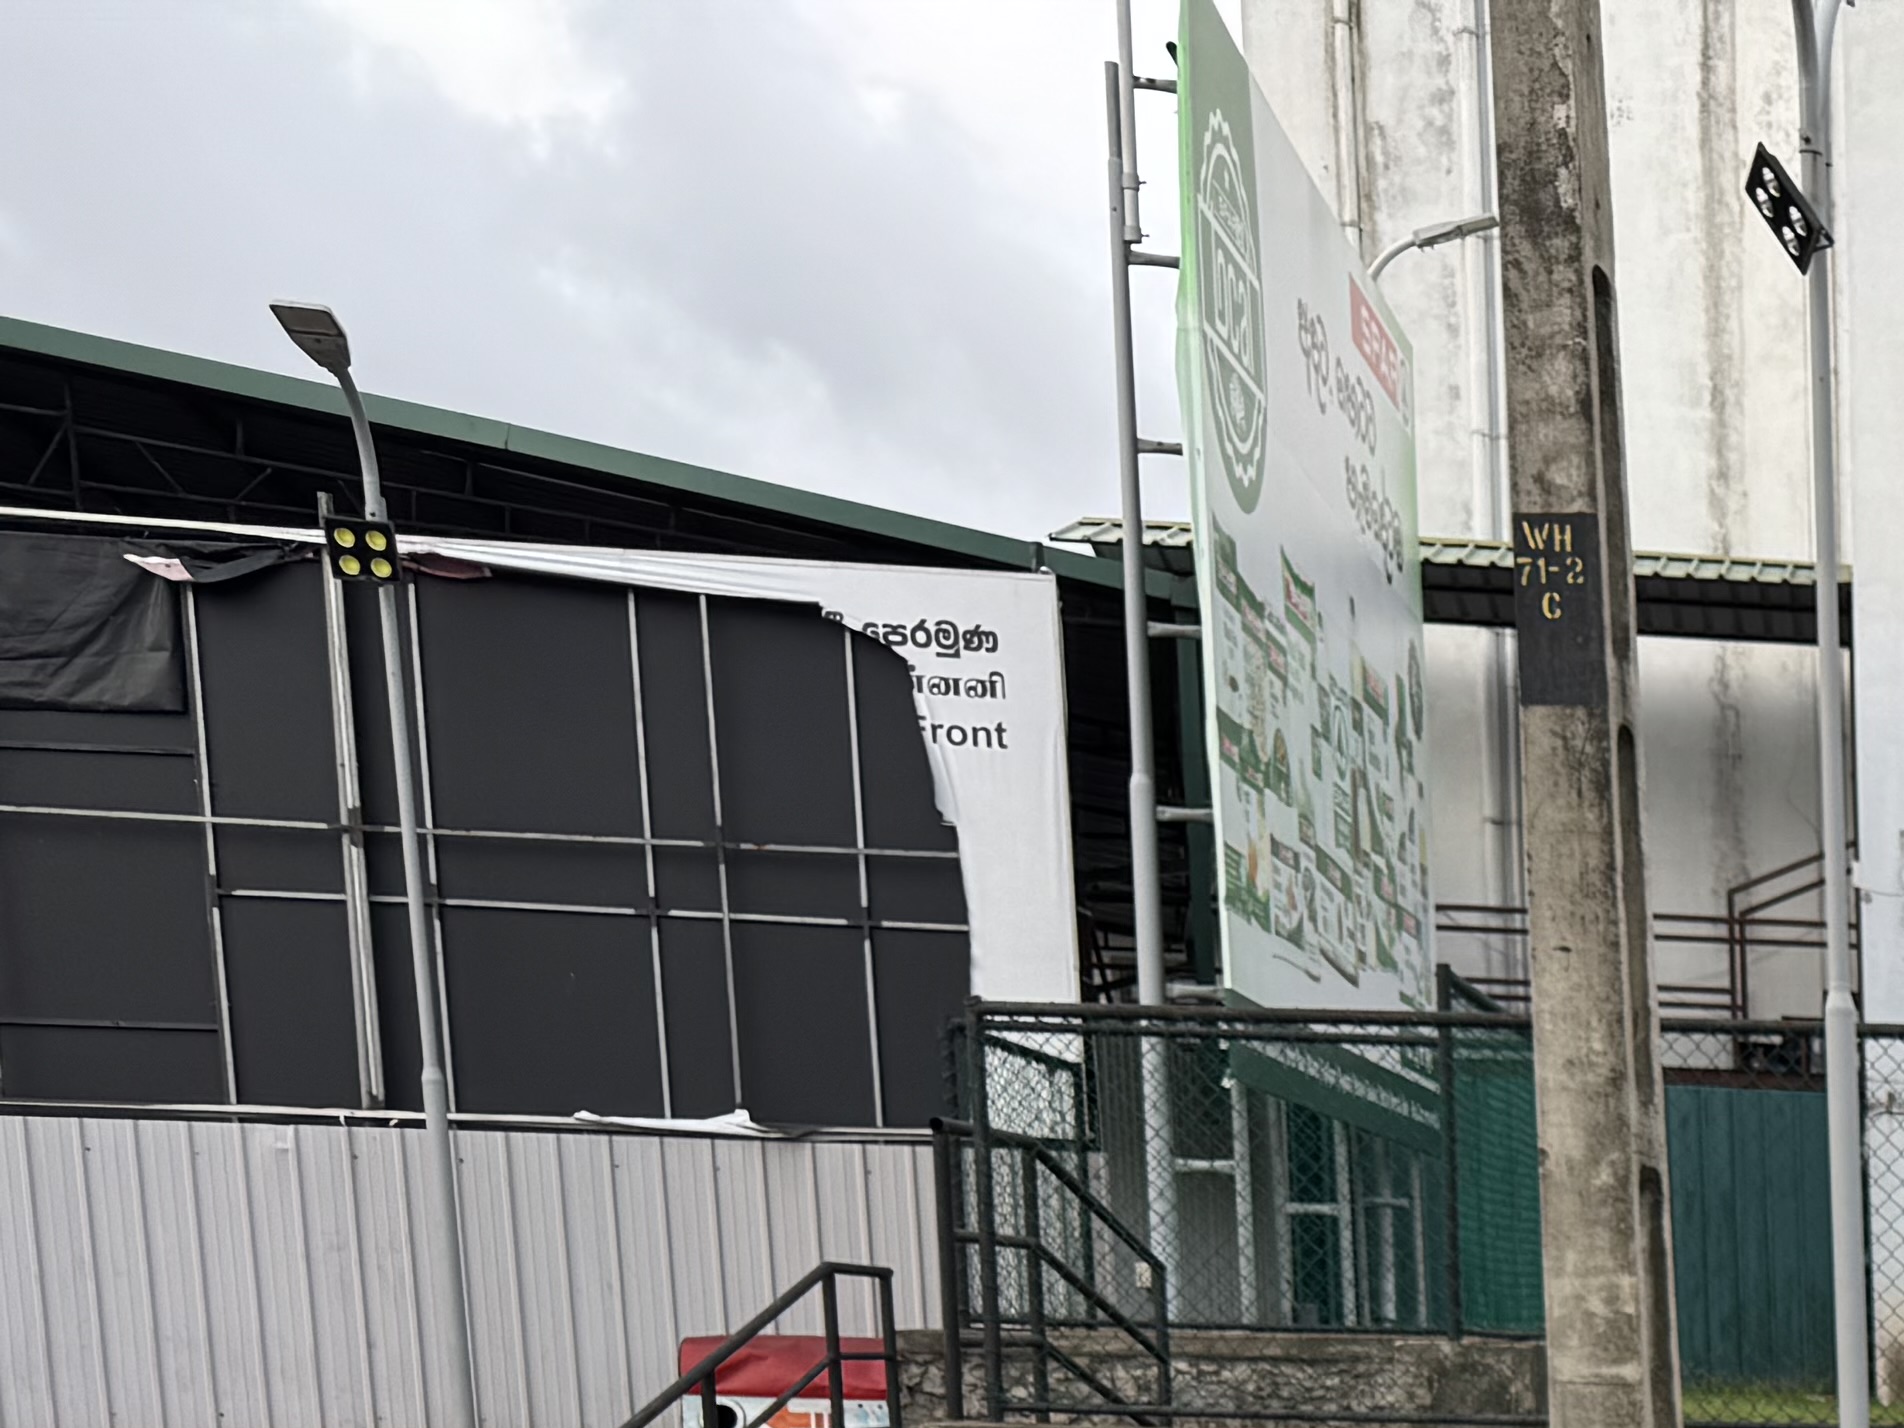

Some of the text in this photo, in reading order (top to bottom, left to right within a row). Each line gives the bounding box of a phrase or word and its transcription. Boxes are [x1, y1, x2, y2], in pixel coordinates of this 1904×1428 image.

[1522, 521, 1571, 552] WH
[1516, 557, 1584, 586] 71-2
[1542, 592, 1561, 619] C
